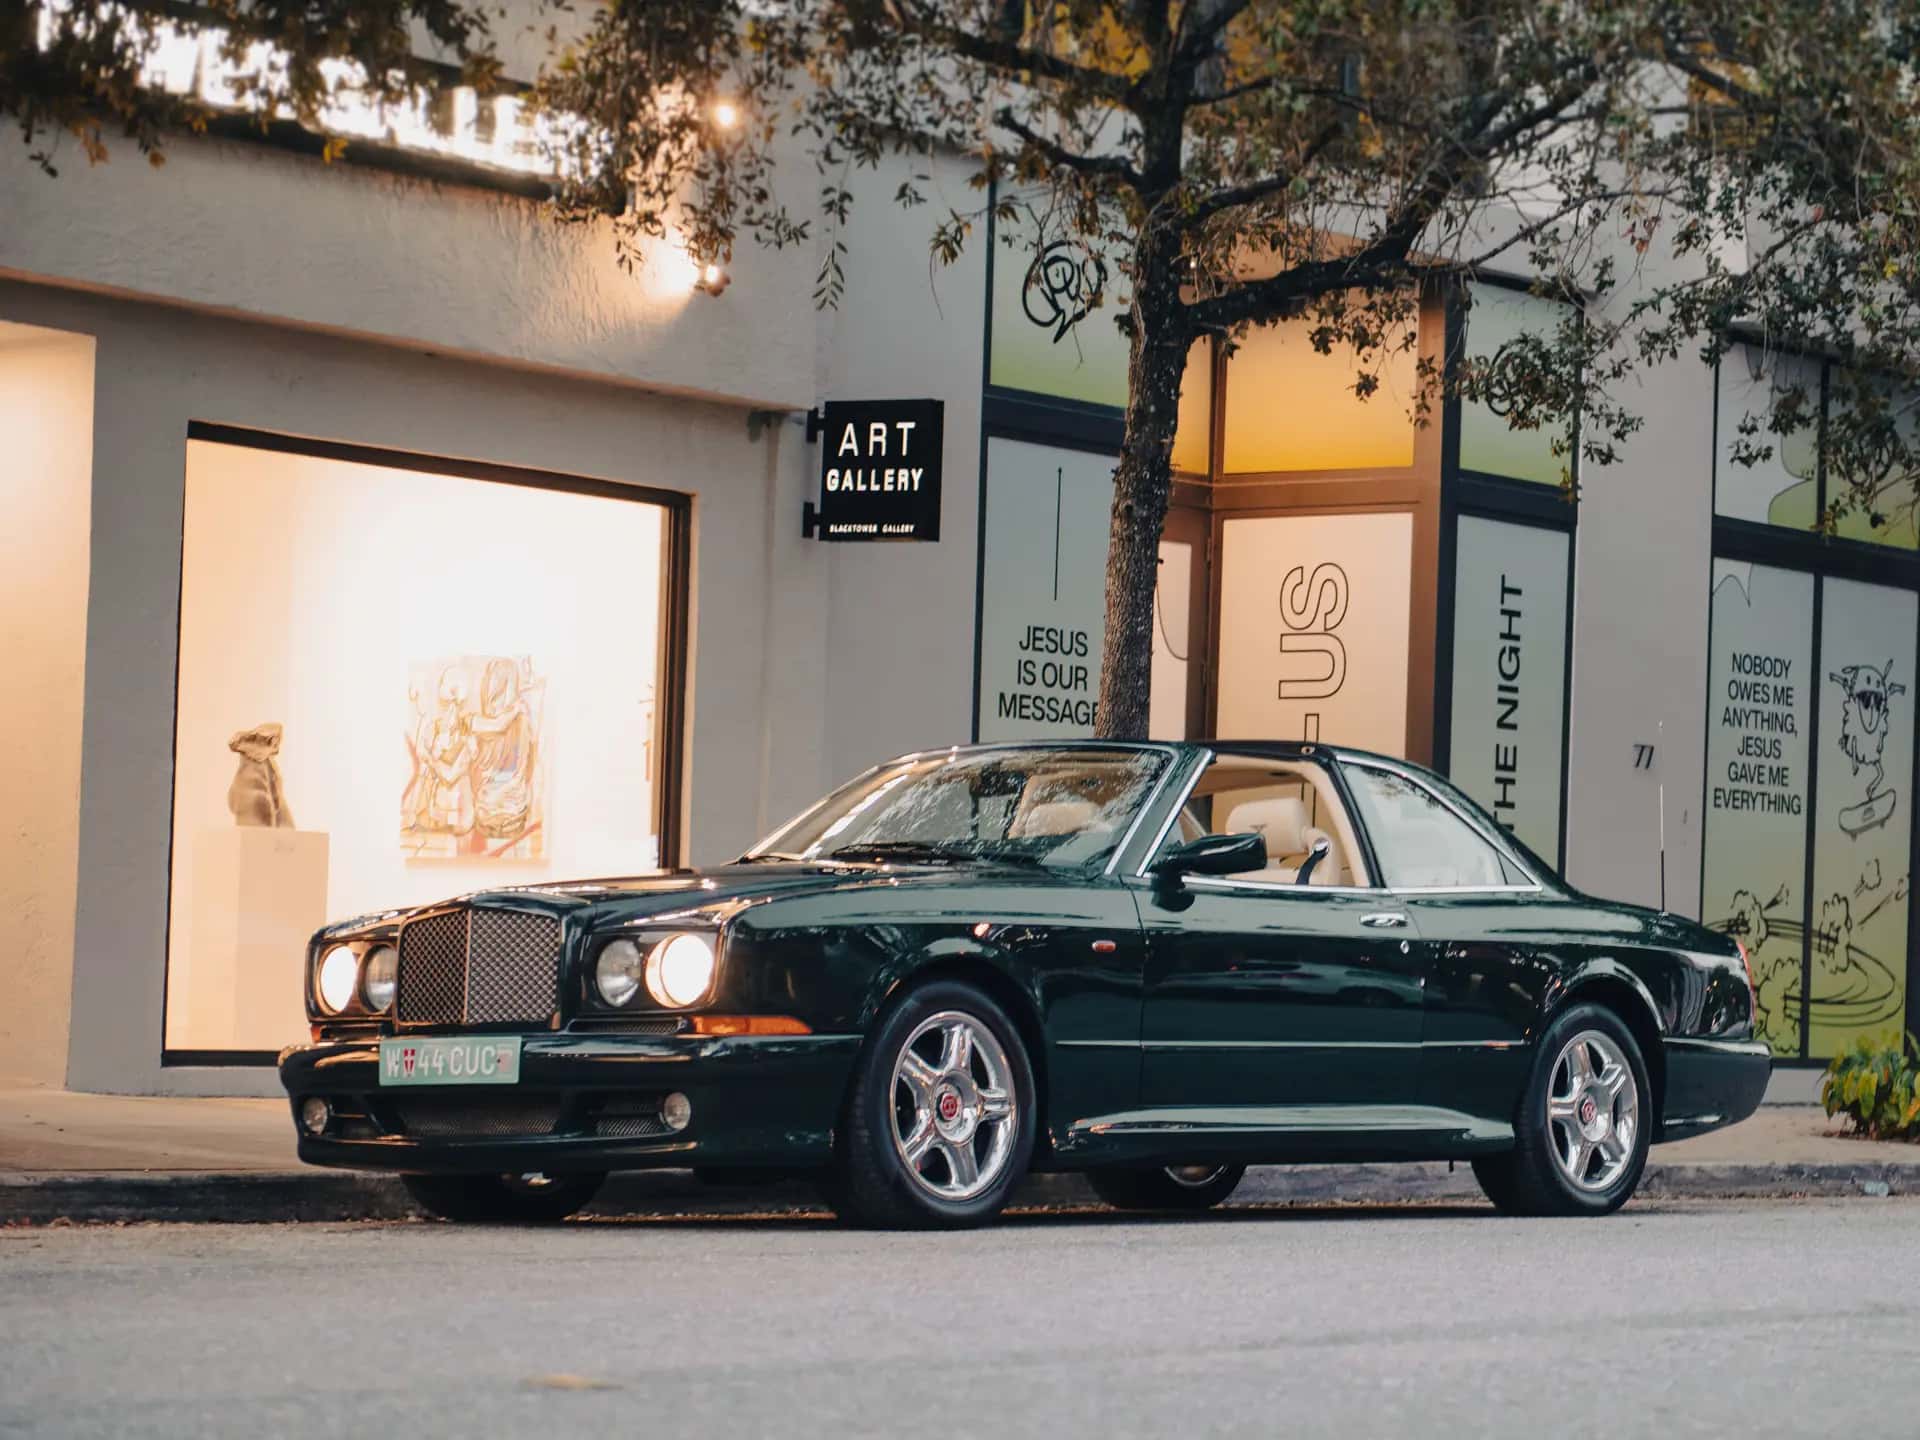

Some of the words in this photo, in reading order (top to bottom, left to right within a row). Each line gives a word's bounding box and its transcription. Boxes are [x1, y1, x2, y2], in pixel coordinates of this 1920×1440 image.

[838, 422, 916, 457] ART
[826, 468, 924, 492] GALLERY
[829, 523, 878, 533] BLACKTOWER
[882, 523, 915, 533] GALLERY
[1019, 625, 1088, 657] JESUS
[1495, 573, 1523, 731] NIGHT
[1017, 659, 1037, 686] IS
[1042, 662, 1089, 691] OUR
[1731, 652, 1792, 679] NOBODY
[1728, 680, 1770, 704] OWES
[1773, 686, 1795, 707] ME
[1722, 707, 1798, 738] ANYTHING,
[1633, 743, 1655, 770] 77
[1737, 736, 1782, 760] JESUS
[1728, 762, 1765, 785] GAVE
[1768, 766, 1789, 788] ME
[1713, 788, 1801, 815] EVERYTHING
